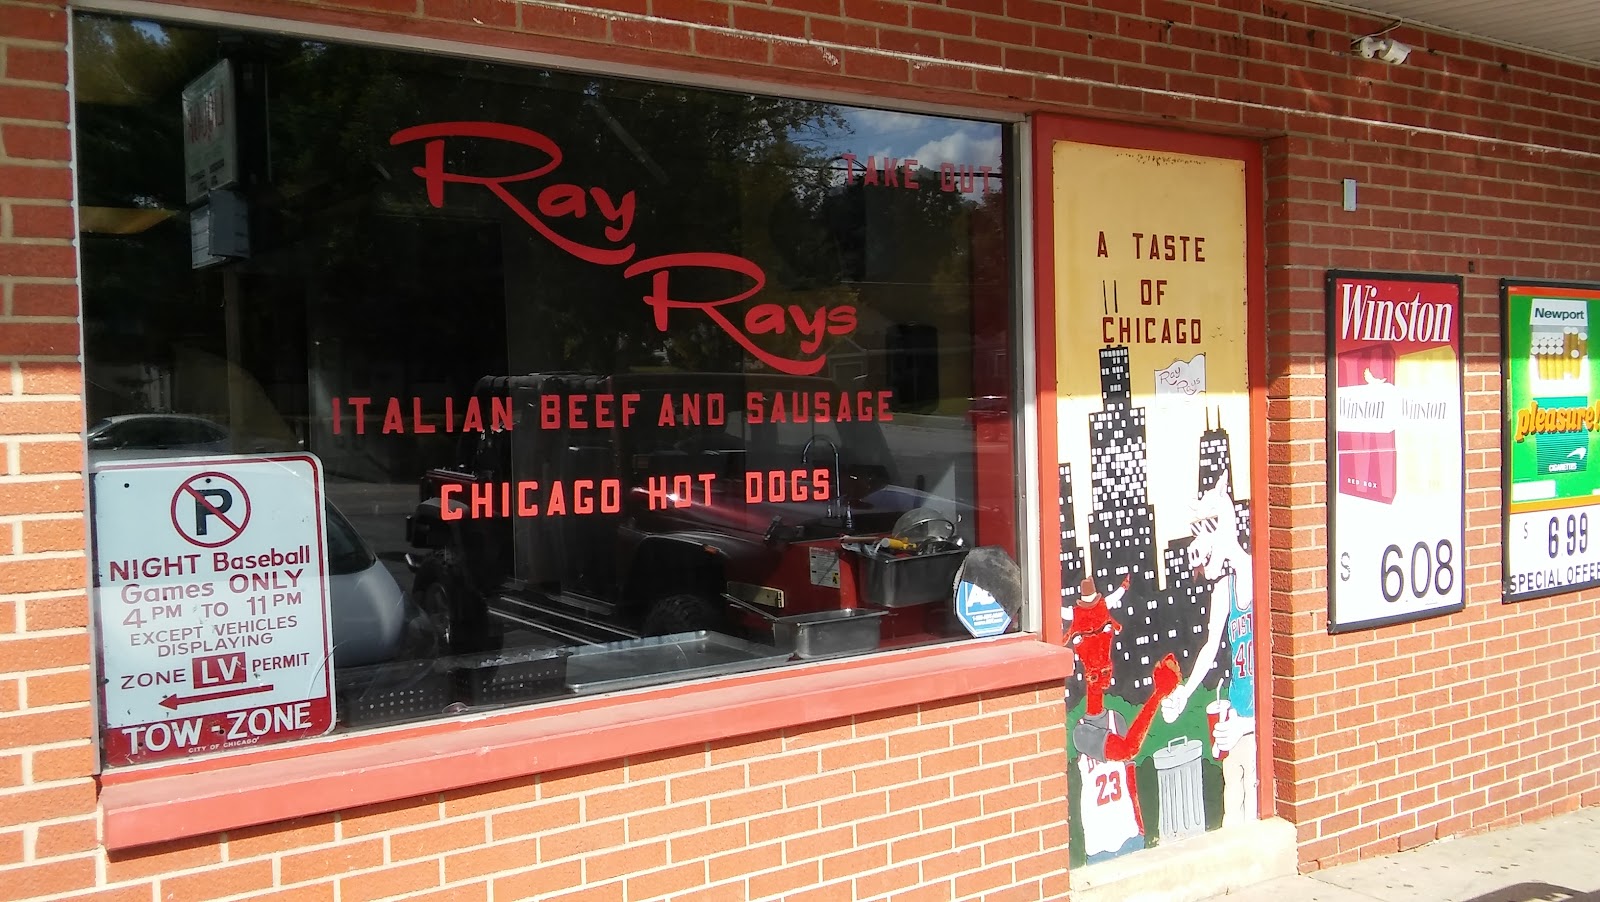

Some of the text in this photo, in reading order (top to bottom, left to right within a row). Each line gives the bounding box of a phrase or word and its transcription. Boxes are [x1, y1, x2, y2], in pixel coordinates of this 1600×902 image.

[842, 153, 992, 195] TAKE OUT
[390, 121, 635, 265] Ray
[1097, 231, 1206, 262] A TASTE
[1140, 280, 1167, 305] OF
[624, 252, 857, 376] Rays
[1342, 284, 1452, 342] Winston
[1534, 307, 1585, 321] Newport
[1103, 316, 1202, 344] CHICAGO
[332, 391, 894, 435] ITALIAN BEEF AND SAUSAGE
[1339, 397, 1385, 419] Winston
[1401, 397, 1447, 420] Winston
[440, 469, 830, 521] CHICAGO HOT DOGS
[1347, 477, 1378, 489] RED BOX
[110, 545, 310, 581] NIGHT Baseball
[121, 568, 303, 605] Games ONLY
[1509, 568, 1562, 594] SPECIAL
[201, 602, 229, 618] TO
[131, 615, 297, 647] EXCEPT VEHICLES
[158, 632, 273, 657] DISPLAYING
[121, 652, 310, 690] ZONE LV PERMIT
[188, 745, 207, 753] CITY
[223, 737, 258, 748] CHICAGO
[1095, 770, 1122, 807] 23
